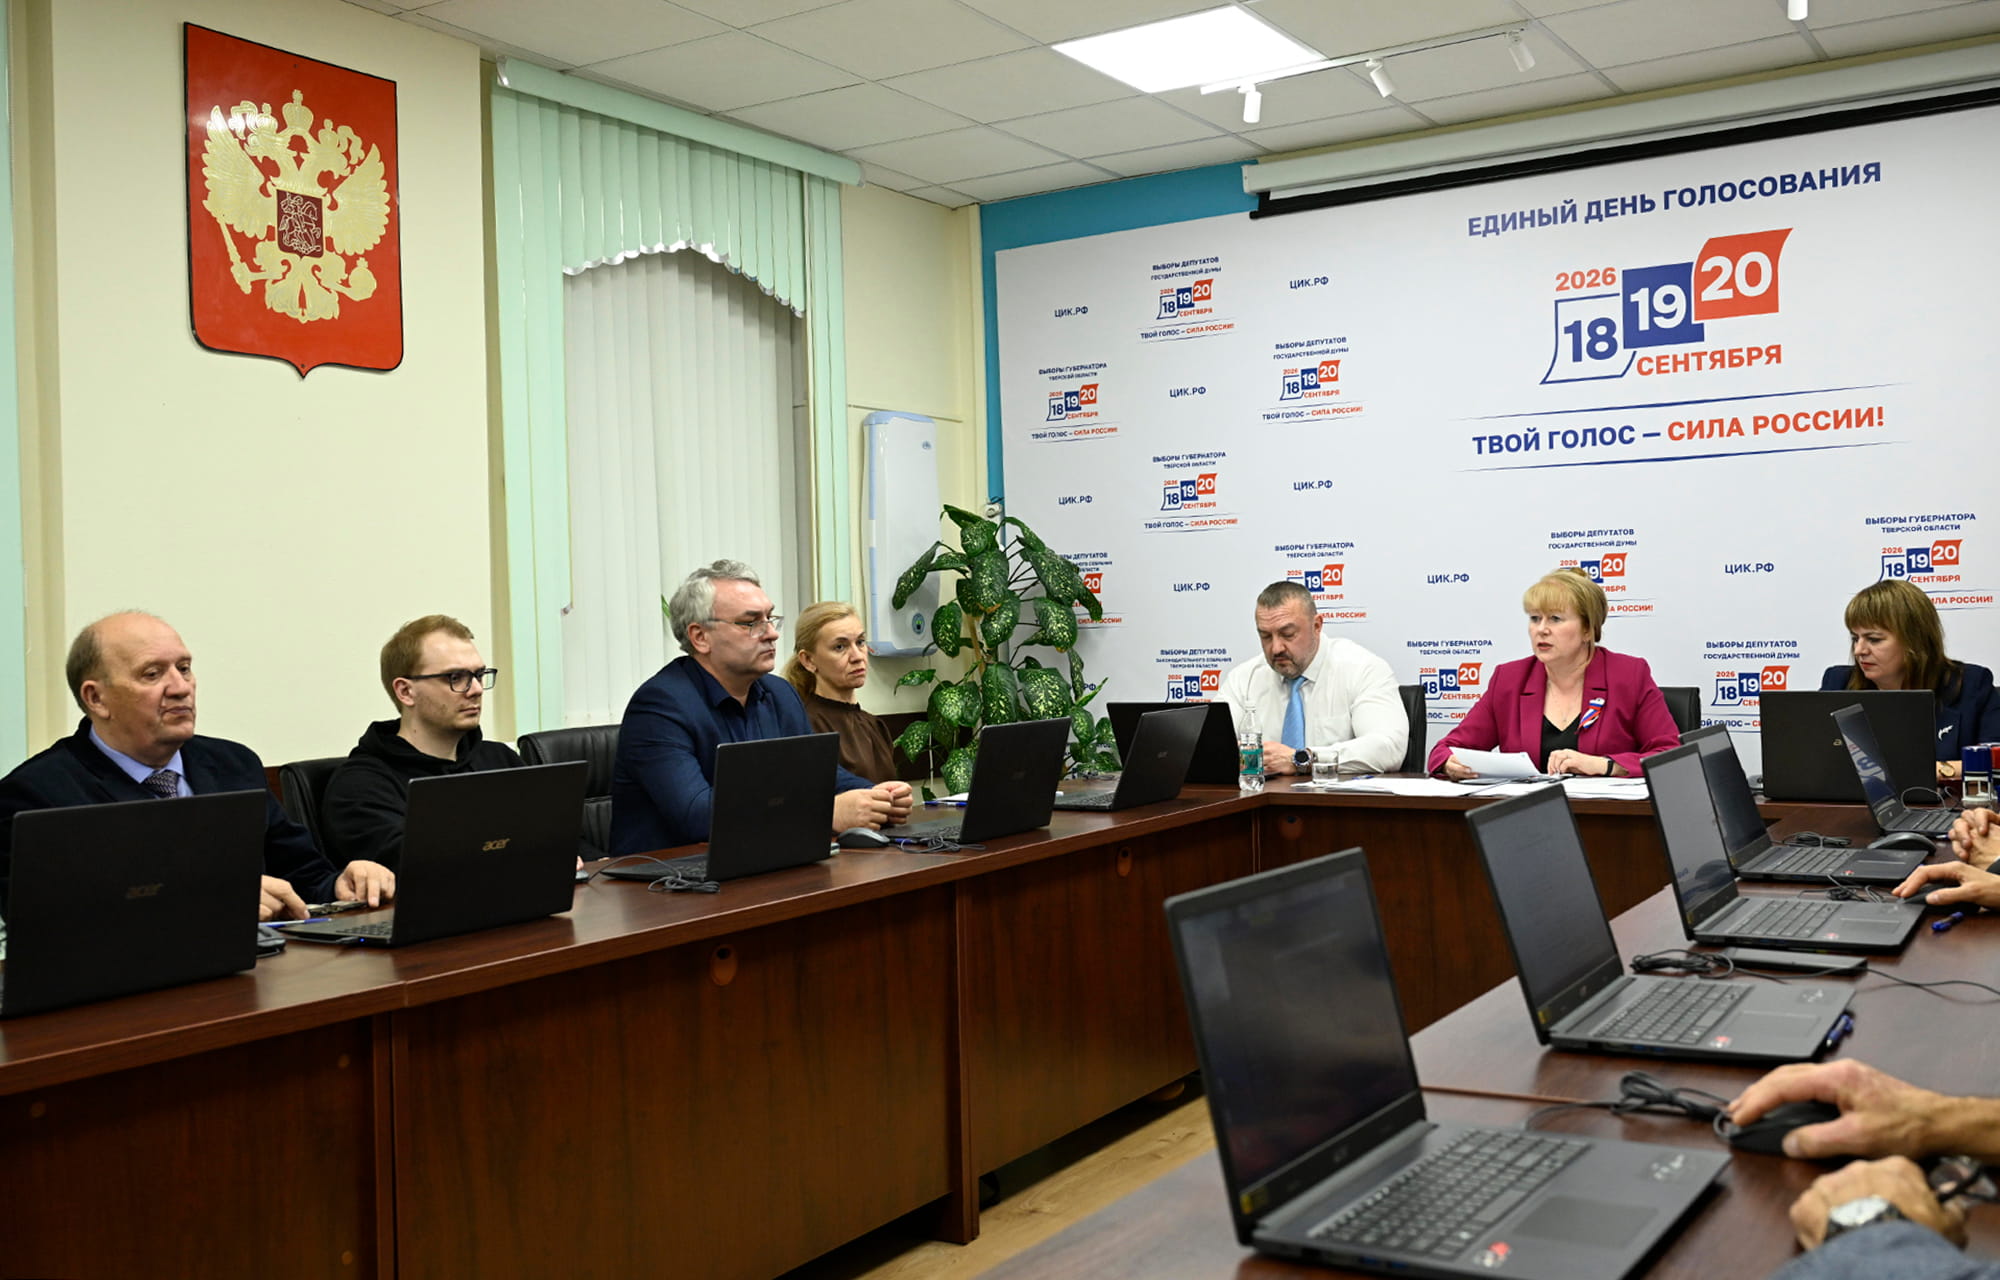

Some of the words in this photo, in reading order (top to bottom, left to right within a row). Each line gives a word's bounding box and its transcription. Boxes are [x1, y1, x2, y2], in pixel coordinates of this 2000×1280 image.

[1468, 199, 1577, 238] ЕДИНЫЙ
[1584, 195, 1655, 223] ДЕНЬ
[1663, 162, 1881, 209] ГОЛОСОВАНИЯ
[1152, 262, 1180, 270] ВЫБОРЫ
[1182, 257, 1219, 268] ДЕПУТАТОВ
[1290, 276, 1328, 290] ЦИК.РФ
[1556, 267, 1616, 292] 2026
[1163, 301, 1175, 313] 18
[1178, 292, 1191, 305] 19
[1194, 284, 1210, 297] 20
[1054, 306, 1088, 318] ЦИК.РФ
[1180, 308, 1213, 317] СЕНТЯБРЯ
[1564, 317, 1618, 363] 18
[1630, 284, 1687, 331] 19
[1701, 251, 1773, 302] 20
[1141, 331, 1157, 339] ТВОЙ
[1186, 326, 1204, 334] СИЛА
[1306, 337, 1347, 347] ДЕПУТАТОВ
[1273, 348, 1330, 360] ГОСУДАРСТВЕННОЙ
[1636, 344, 1782, 376] СЕНТЯБРЯ
[1066, 363, 1107, 372] ГУБЕРНАТОРА
[1286, 382, 1299, 394] 18
[1302, 373, 1316, 386] 19
[1320, 365, 1337, 378] 20
[1170, 386, 1206, 398] ЦИК.РФ
[1304, 389, 1340, 398] СЕНТЯБРЯ
[1052, 404, 1064, 415] 18
[1066, 396, 1078, 408] 19
[1081, 388, 1096, 400] 20
[1332, 406, 1363, 414] РОССИИ!
[1472, 428, 1540, 455] ТВОЙ
[1548, 425, 1635, 450] ГОЛОС
[1667, 420, 1745, 440] СИЛА
[1752, 406, 1884, 436] РОССИИ!
[1182, 452, 1226, 460] ГУБЕРНАТОРА
[1166, 493, 1179, 504] 18
[1182, 485, 1194, 497] 19
[1198, 478, 1214, 490] 20
[1294, 480, 1332, 491] ЦИК.РФ
[1059, 495, 1093, 505] ЦИК.РФ
[1865, 516, 1907, 525] ВЫБОРЫ
[1909, 513, 1976, 523] ГУБЕРНАТОРА
[1551, 531, 1585, 539] ВЫБОРЫ
[1587, 529, 1634, 537] ДЕПУТАТОВ
[1306, 542, 1354, 550] ГУБЕРНАТОРА
[1548, 541, 1614, 549] ГОСУДАРСТВЕННОЙ
[1603, 558, 1623, 572] 20
[1886, 563, 1905, 577] 18
[1908, 554, 1928, 568] 19
[1933, 545, 1957, 560] 20
[1725, 563, 1774, 575] ЦИК.РФ
[1086, 578, 1100, 589] 20
[1306, 576, 1320, 588] 19
[1324, 569, 1341, 581] 20
[1427, 573, 1470, 584] ЦИК.РФ
[1911, 575, 1960, 583] СЕНТЯБРЯ
[1174, 583, 1210, 592] ЦИК.РФ
[1950, 596, 1993, 604] РОССИИ!
[1171, 688, 1183, 699] 18
[1186, 681, 1198, 693] 19
[1202, 675, 1218, 686] 20
[1423, 682, 1438, 694] 18
[1441, 674, 1456, 687] 19
[1460, 668, 1478, 680] 20
[1720, 686, 1737, 700] 18
[1740, 678, 1758, 692] 19
[1763, 671, 1785, 685] 20
[482, 838, 510, 851] acer
